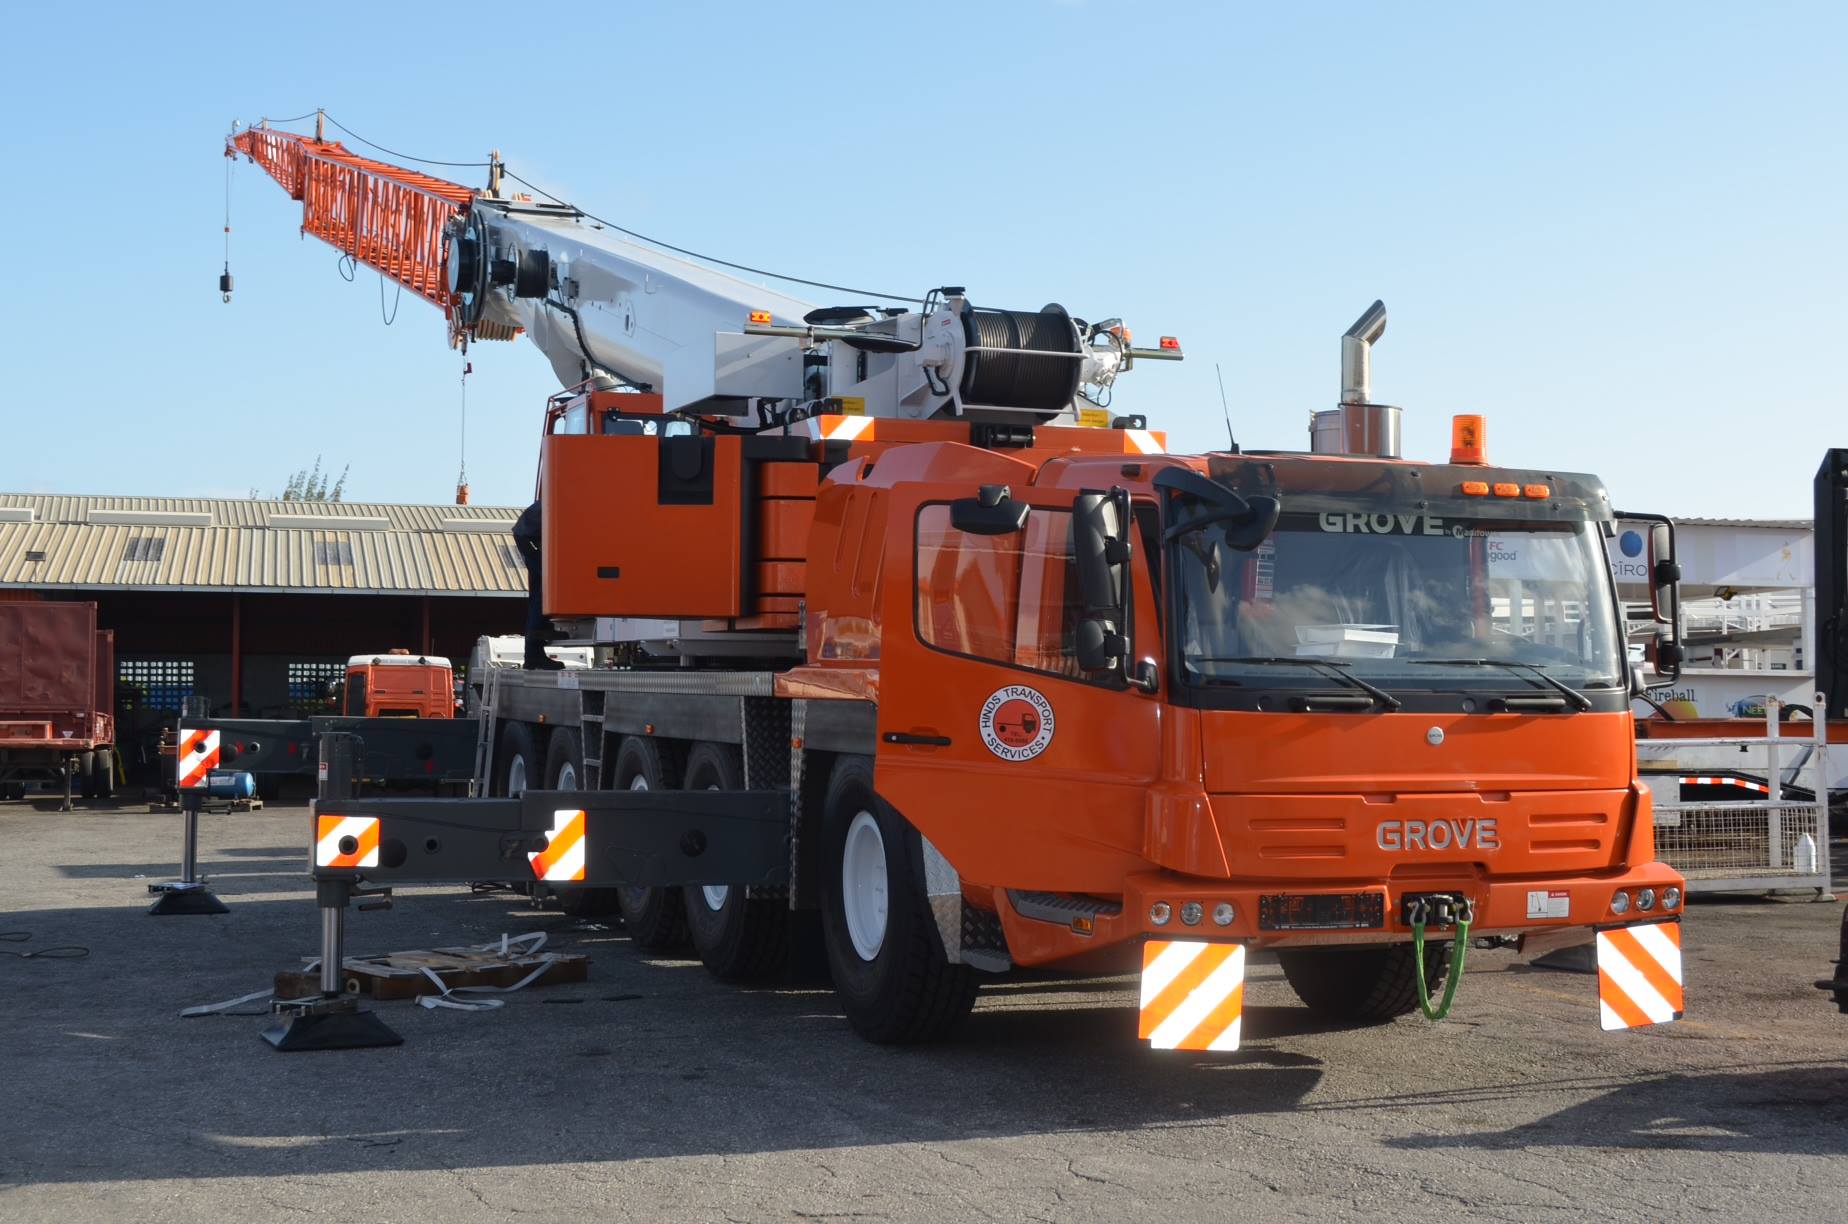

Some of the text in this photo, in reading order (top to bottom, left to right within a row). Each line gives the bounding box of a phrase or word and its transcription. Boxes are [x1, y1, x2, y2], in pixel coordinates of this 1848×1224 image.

[1319, 512, 1444, 536] GROVE
[1488, 551, 1517, 563] good
[981, 687, 1053, 734] HINDS TRANSPORT
[987, 737, 1045, 760] SERVICES
[1376, 818, 1499, 850] GROVE
